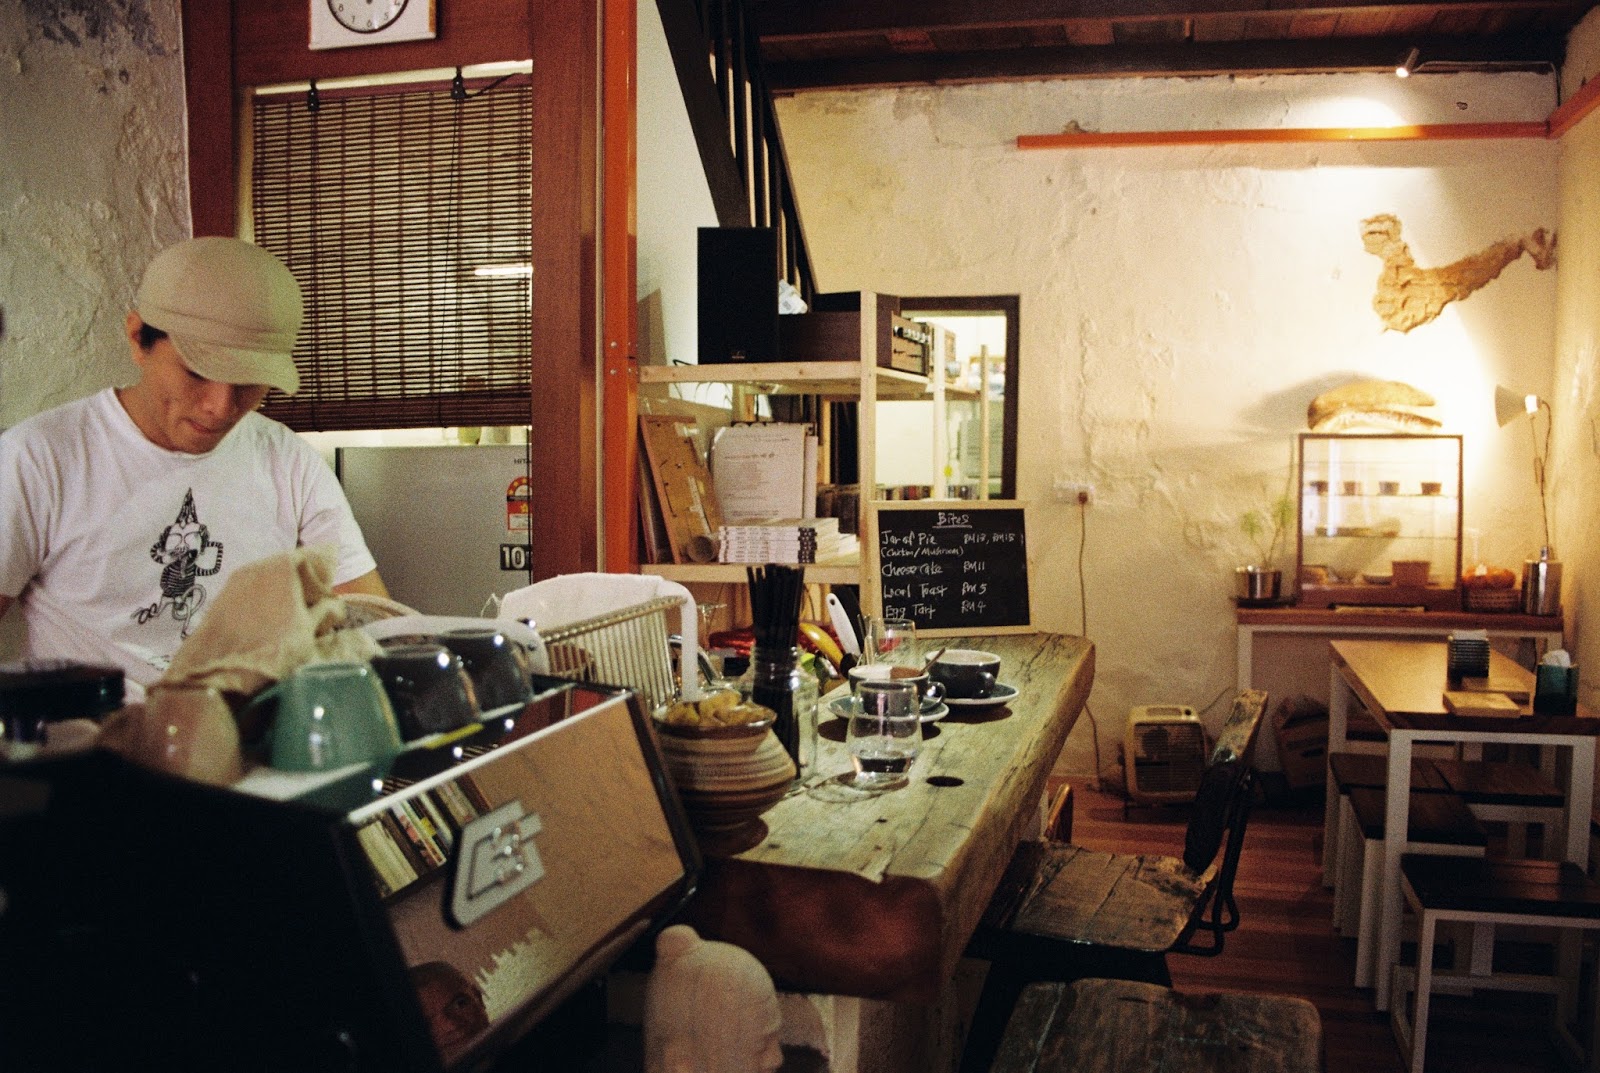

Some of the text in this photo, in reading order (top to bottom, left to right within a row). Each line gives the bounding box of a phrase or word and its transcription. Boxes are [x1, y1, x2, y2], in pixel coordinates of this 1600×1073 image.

[367, 19, 373, 28] 6
[384, 11, 389, 21] 5
[936, 511, 970, 526] Bites
[902, 530, 915, 546] of
[918, 532, 937, 546] Pie
[502, 546, 526, 569] 10
[883, 582, 948, 599] Local Toast
[885, 603, 936, 620] Egg Tart
